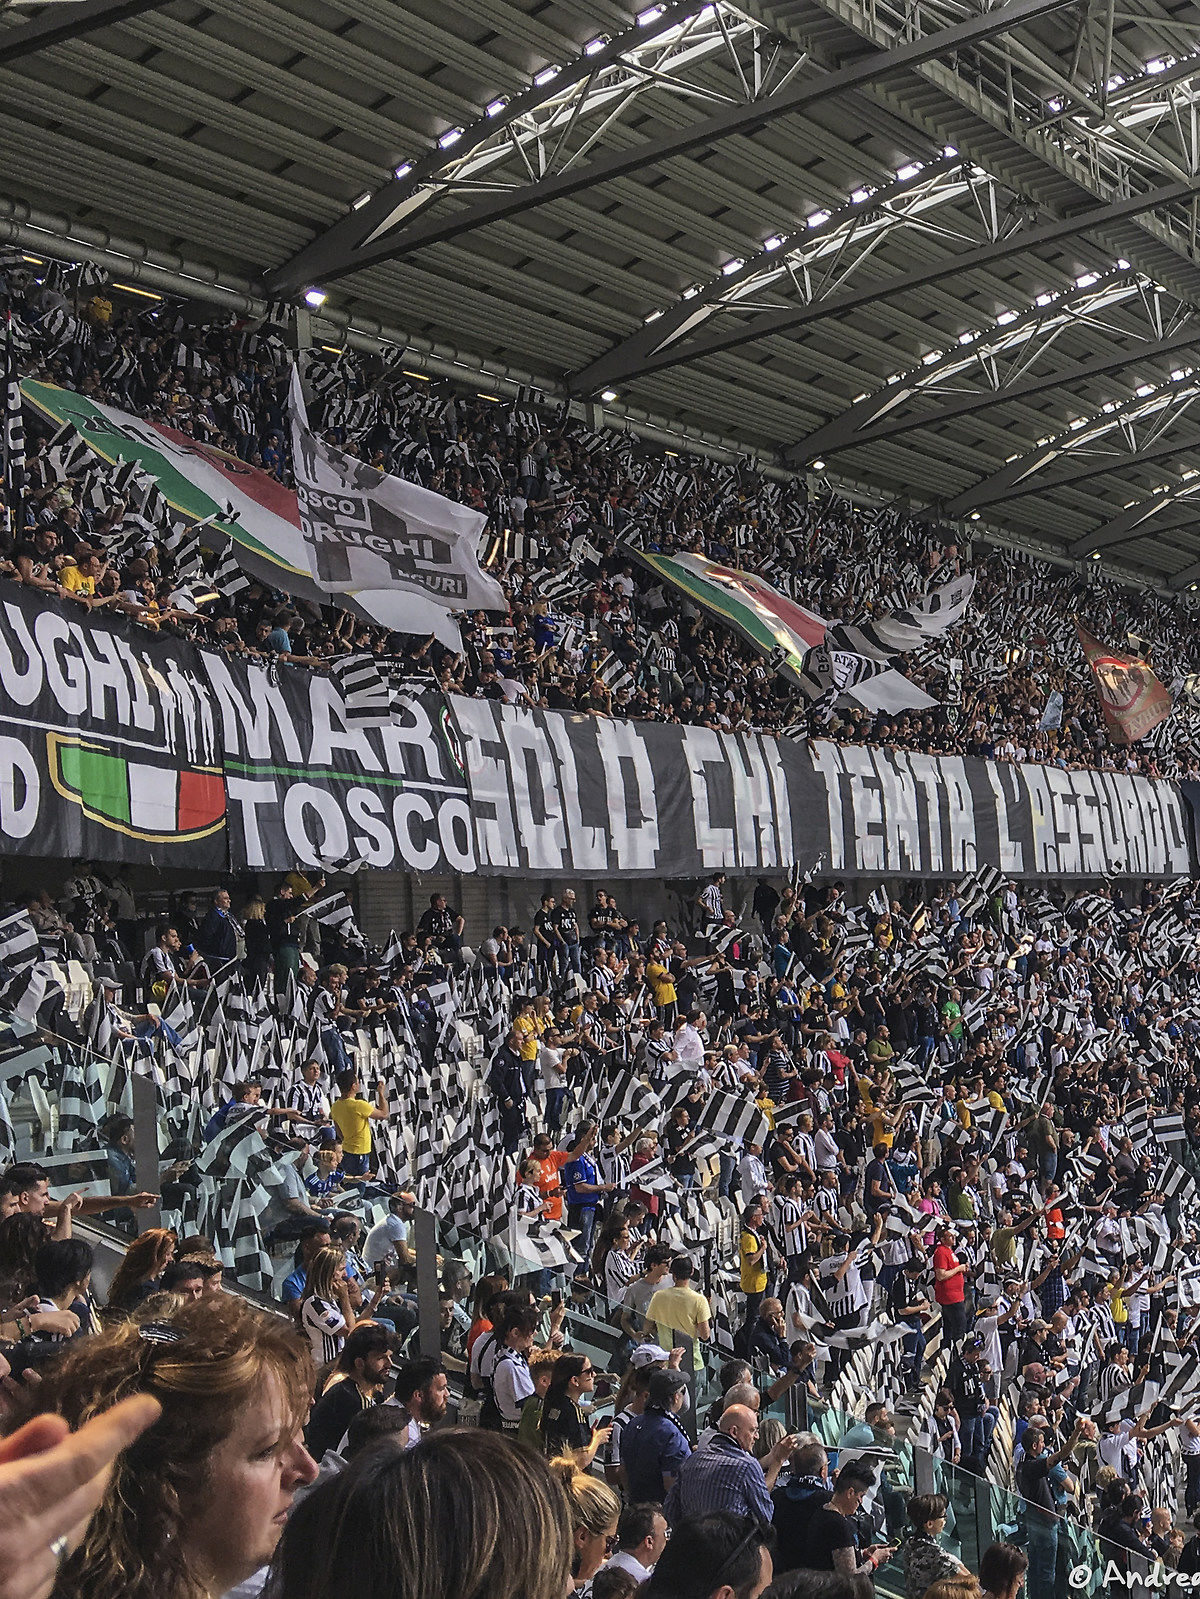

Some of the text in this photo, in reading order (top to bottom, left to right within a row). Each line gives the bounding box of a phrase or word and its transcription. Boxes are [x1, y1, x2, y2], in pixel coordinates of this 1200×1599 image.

[227, 776, 477, 873] TOSCO
[450, 694, 660, 869] SOLO
[681, 724, 794, 867] CHI
[813, 740, 977, 872] TENTA
